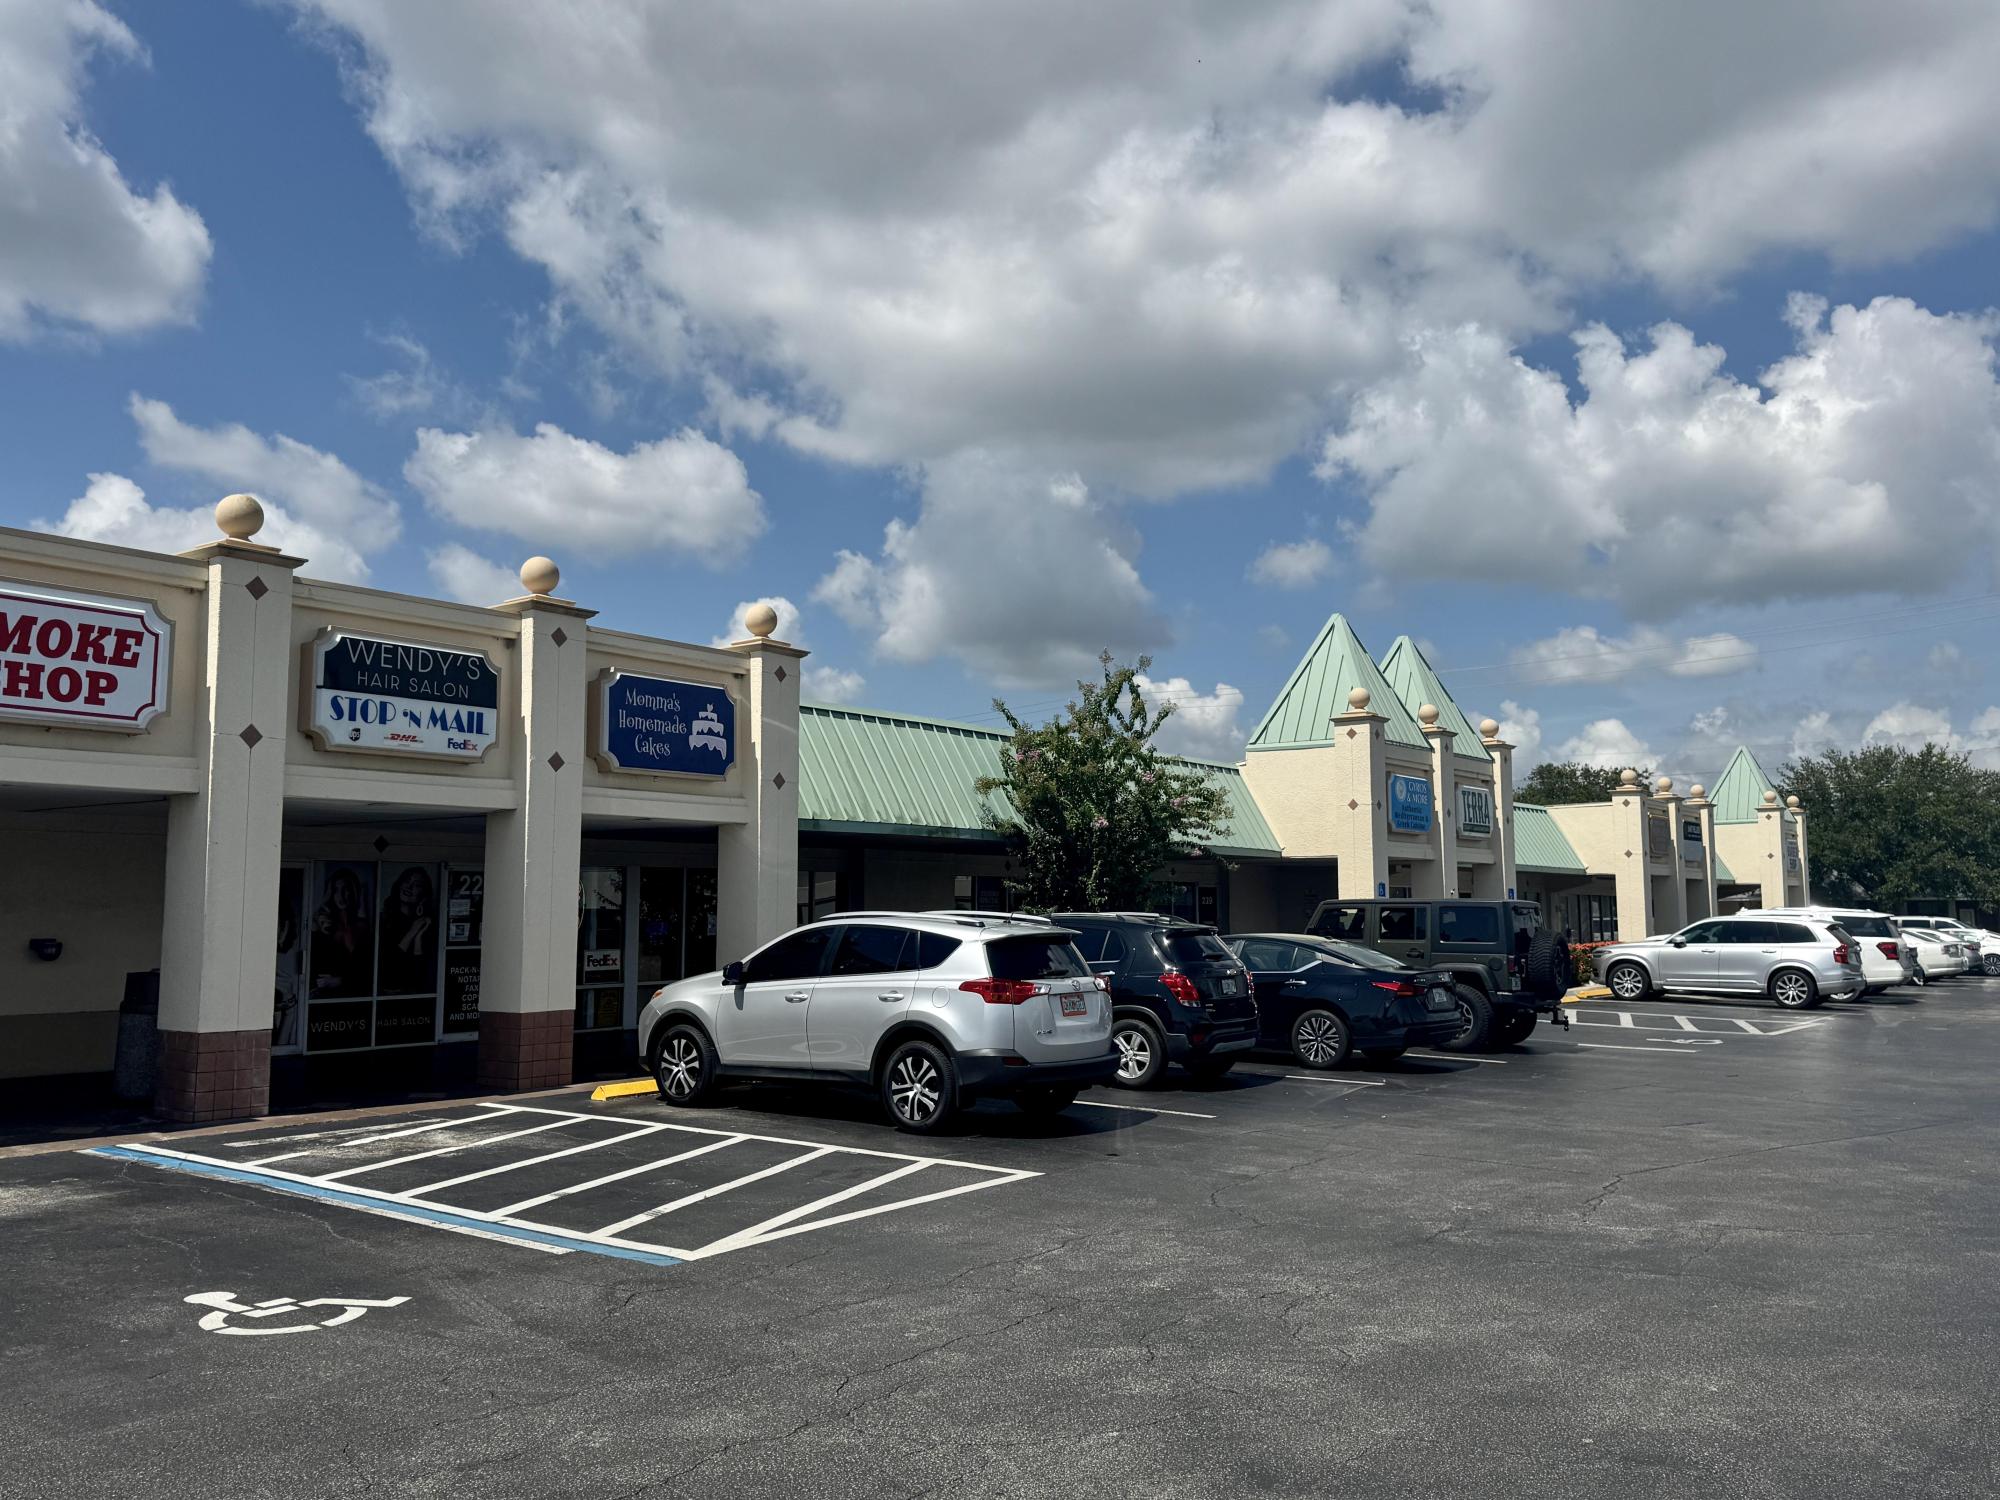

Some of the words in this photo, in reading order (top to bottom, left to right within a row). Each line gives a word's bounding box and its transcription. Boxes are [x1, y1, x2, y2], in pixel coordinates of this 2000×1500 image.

[346, 638, 481, 680] WENDY'S
[0, 661, 118, 706] HOP
[357, 671, 399, 690] HAIR
[409, 678, 468, 698] SALON
[625, 688, 681, 712] Momma's
[330, 695, 397, 724] STOP
[402, 708, 421, 729] 'N
[427, 706, 490, 735] MAIL
[619, 709, 687, 734] Homemade
[389, 733, 419, 743] DHL
[447, 738, 478, 751] FedEx
[634, 734, 671, 759] Cakes
[1461, 790, 1490, 825] TERRA
[587, 954, 618, 967] FedEx
[462, 993, 479, 1001] COP
[462, 1003, 478, 1011] SCA
[310, 1019, 367, 1033] WENDY'S
[450, 1012, 465, 1021] AND
